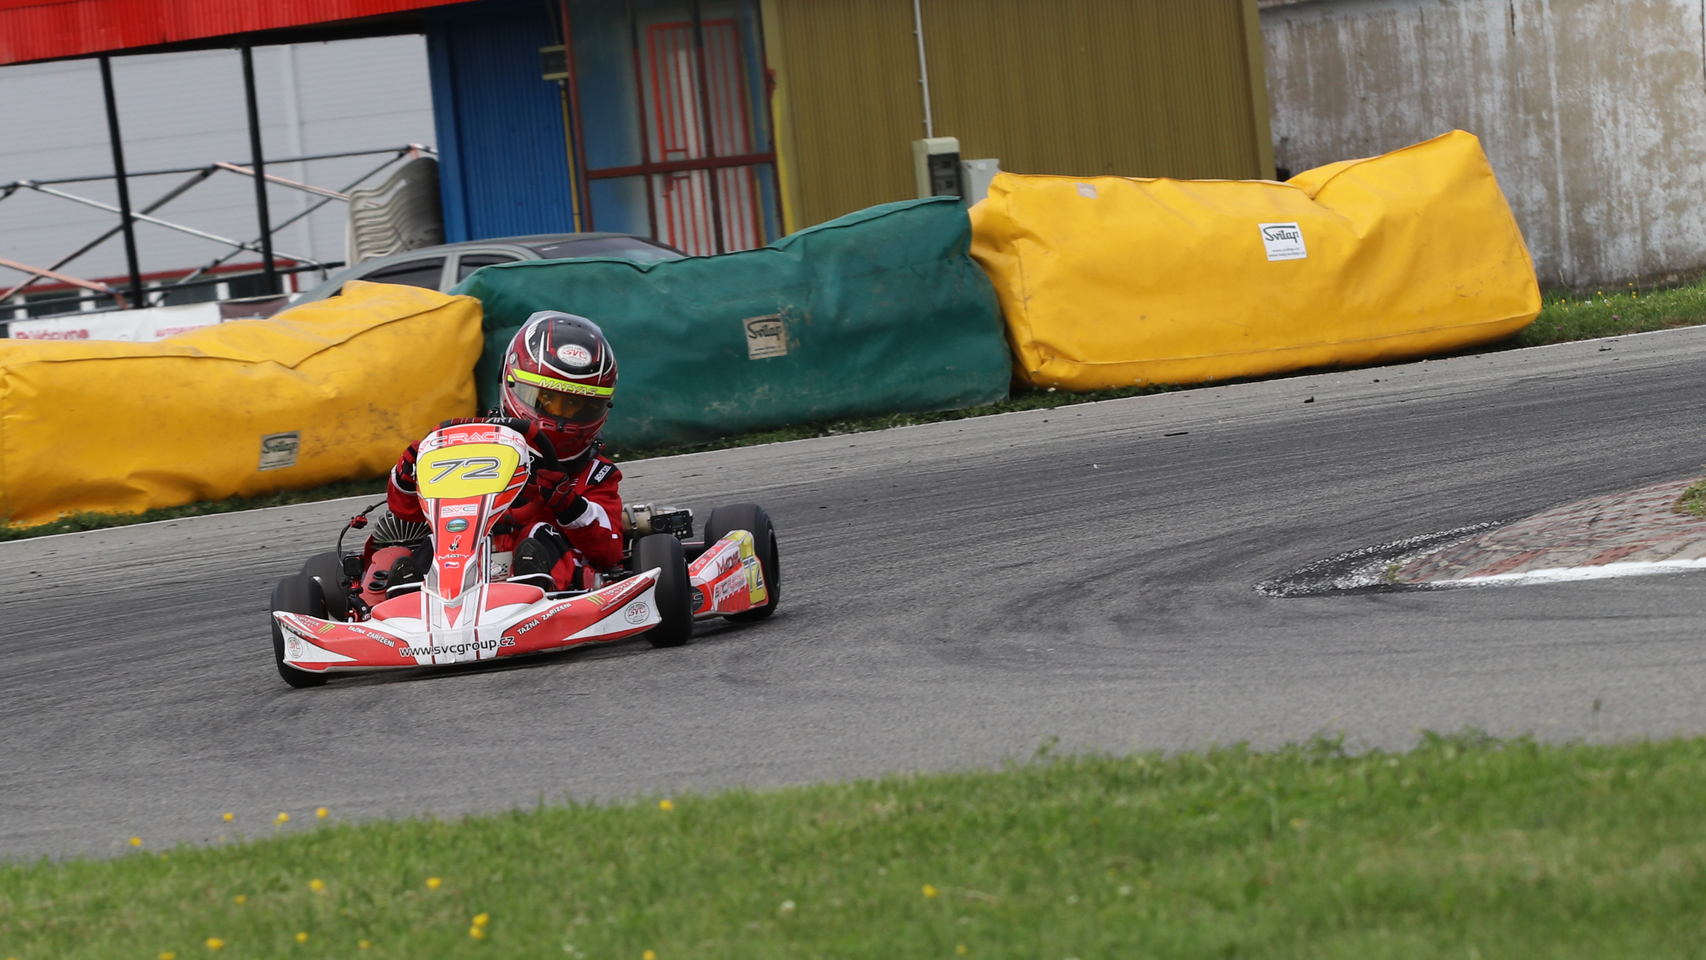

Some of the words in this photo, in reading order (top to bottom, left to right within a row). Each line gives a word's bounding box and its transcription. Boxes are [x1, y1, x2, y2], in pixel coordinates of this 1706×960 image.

[1263, 226, 1299, 243] Svitap
[539, 379, 598, 397] MATYAS
[429, 457, 501, 484] 72
[399, 636, 516, 658] www.svcgroup.cz
